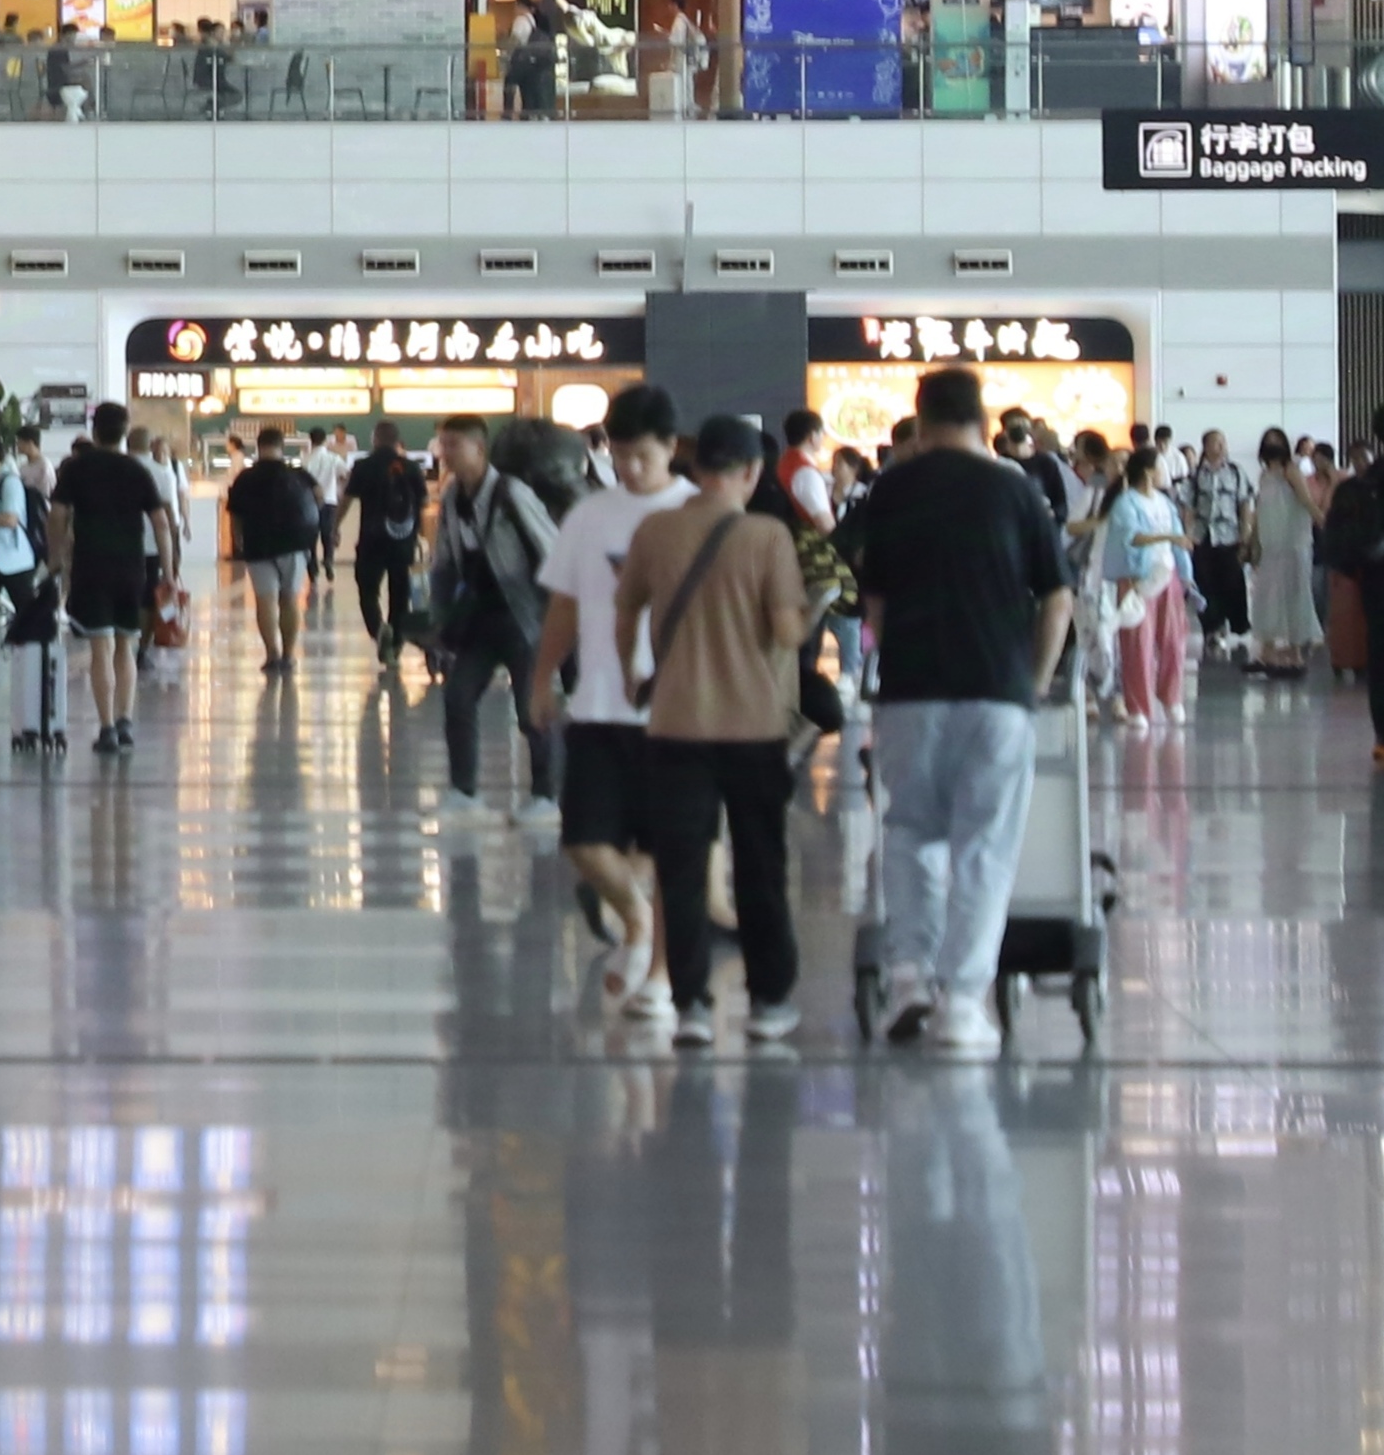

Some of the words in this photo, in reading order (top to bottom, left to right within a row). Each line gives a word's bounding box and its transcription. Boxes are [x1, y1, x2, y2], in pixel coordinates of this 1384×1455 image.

[1200, 123, 1315, 155] 行李打包
[1200, 157, 1285, 182] Baggage
[1291, 156, 1367, 182] Packing
